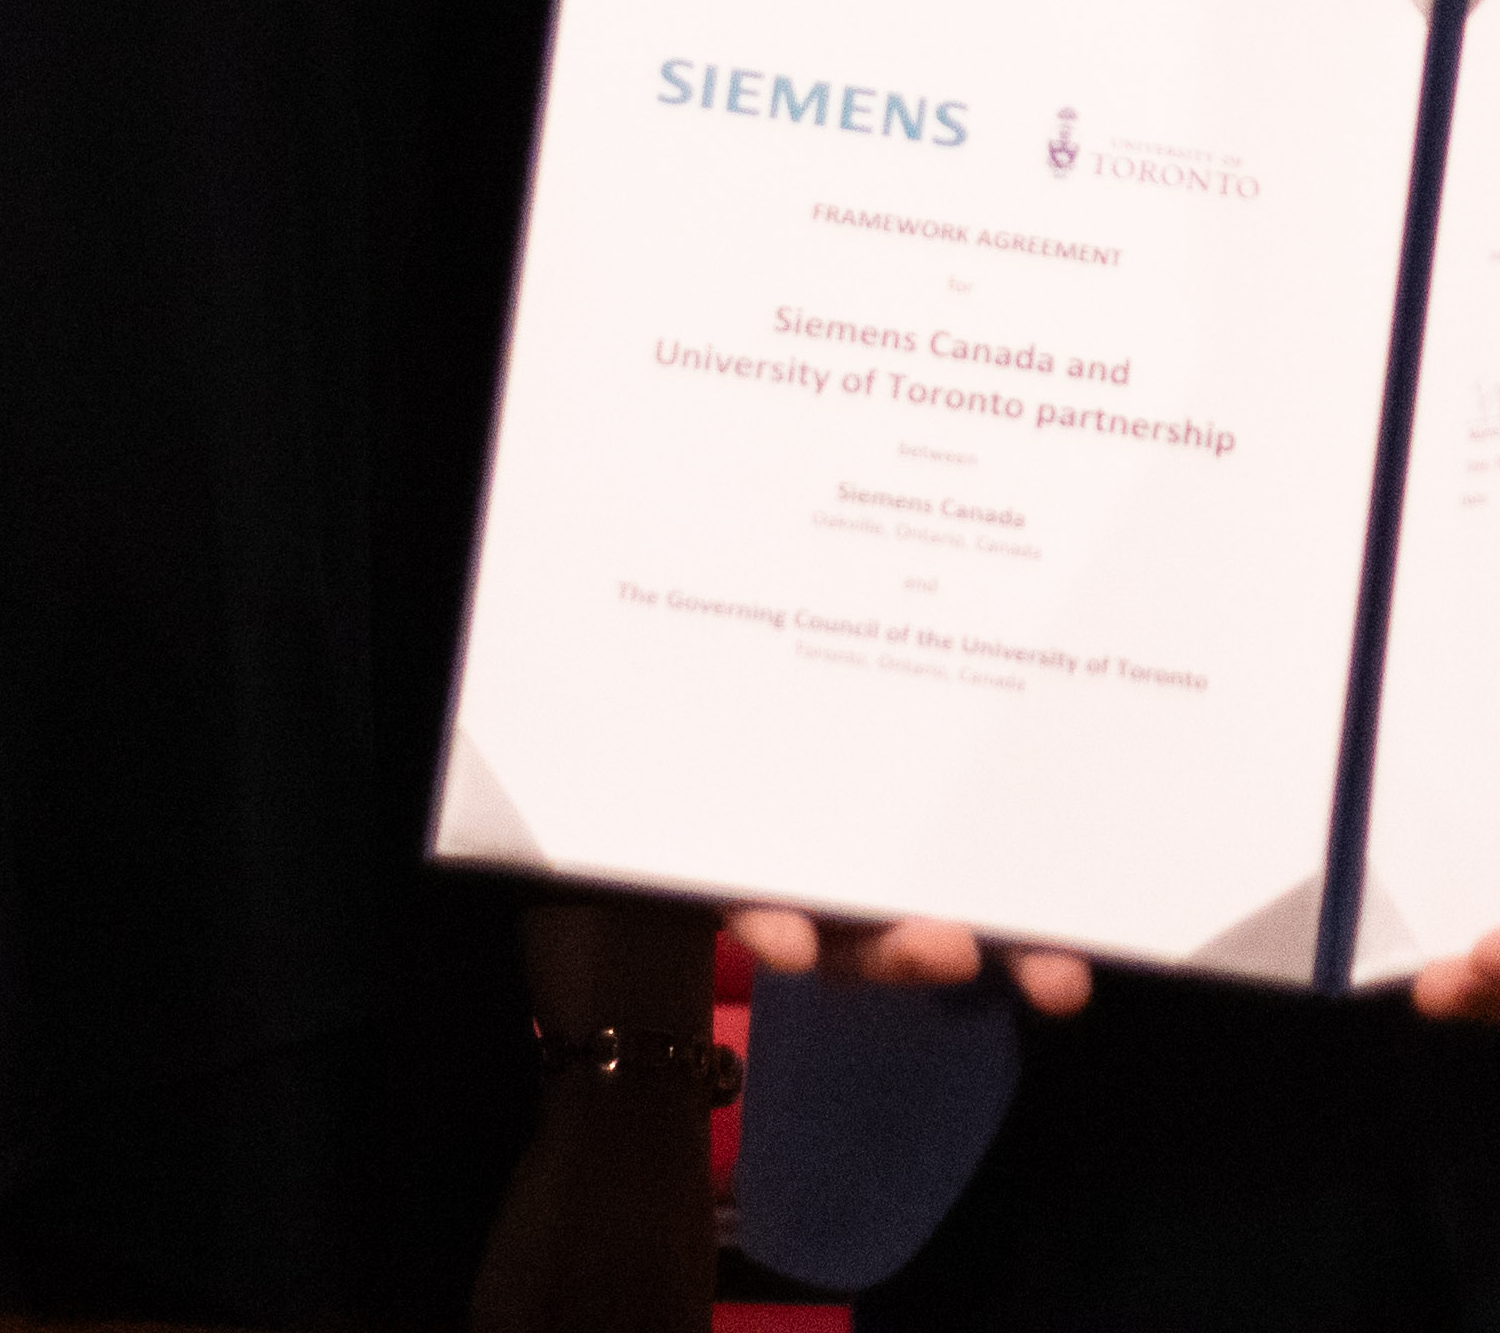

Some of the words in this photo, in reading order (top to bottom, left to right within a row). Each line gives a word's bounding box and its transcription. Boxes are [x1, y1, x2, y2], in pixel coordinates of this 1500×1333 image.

[657, 58, 969, 149] SIEMENS
[1091, 152, 1261, 201] TORONTO
[812, 201, 969, 245] FRAMEWORK
[977, 228, 1123, 268] AGREEMENT
[773, 304, 918, 355] Siemens
[929, 330, 1056, 376] Canada
[1066, 352, 1132, 387] and
[654, 337, 830, 396] University
[841, 367, 875, 395] of
[887, 373, 1025, 421] Toronto
[1035, 399, 1237, 457] partnership
[837, 482, 933, 518] Siemens
[940, 499, 1027, 530] Canada
[617, 581, 659, 607] The
[666, 589, 787, 630] Governing
[794, 609, 880, 641] Council
[887, 624, 909, 644] of
[916, 628, 953, 651] the
[962, 634, 1078, 677] University
[1086, 656, 1111, 676] of
[1117, 661, 1209, 692] Toronto
